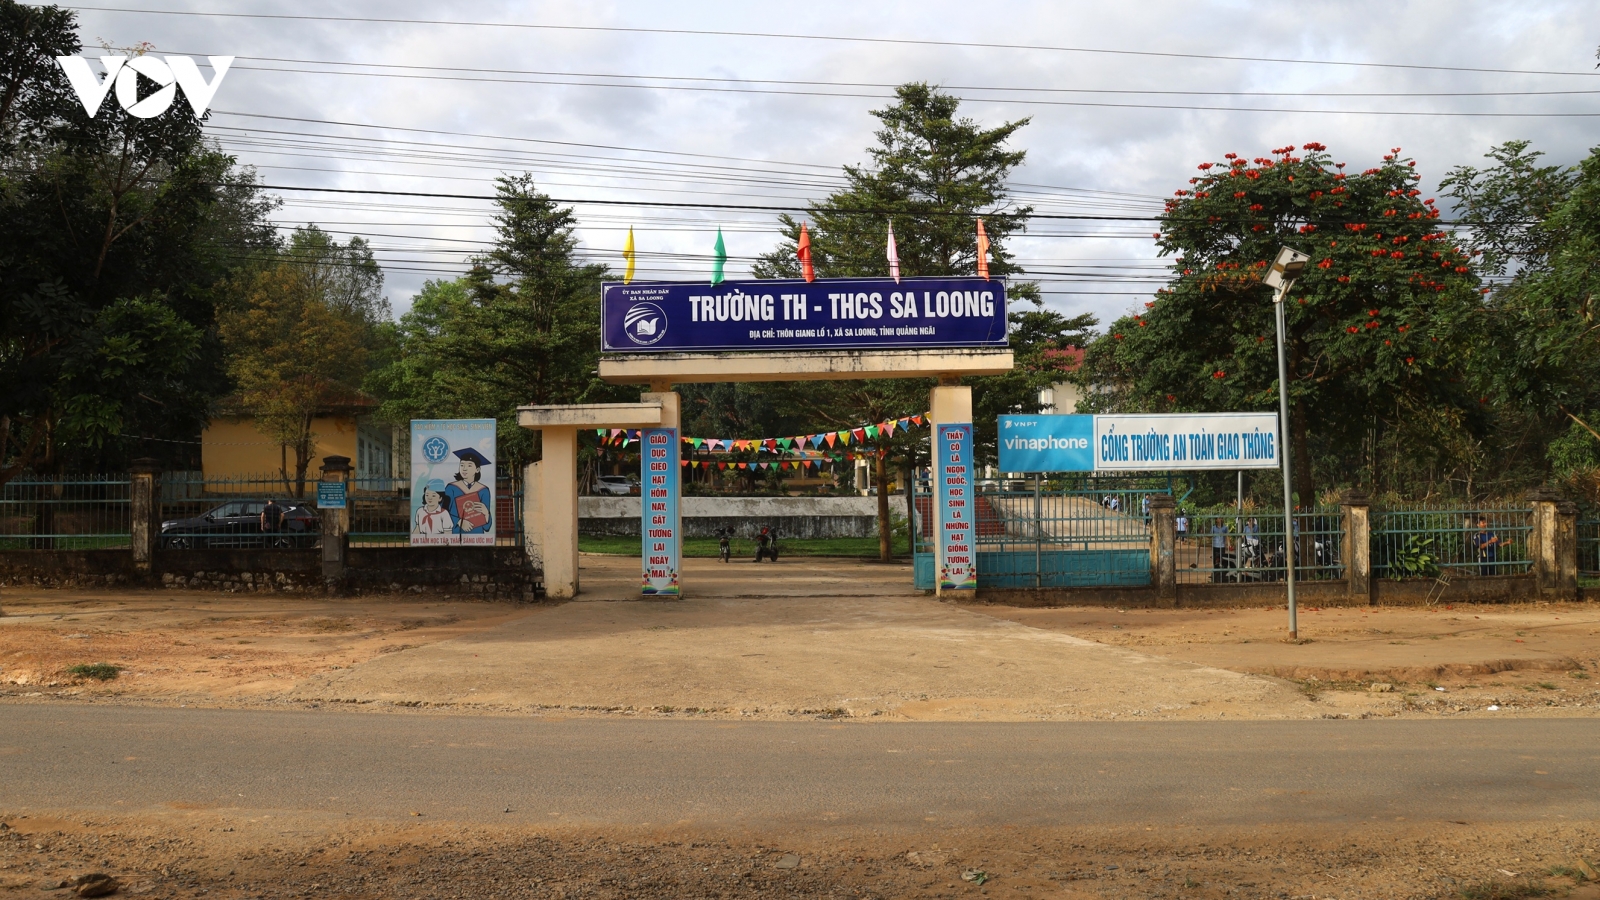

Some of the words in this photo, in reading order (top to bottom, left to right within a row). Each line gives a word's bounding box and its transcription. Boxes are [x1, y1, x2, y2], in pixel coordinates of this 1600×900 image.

[689, 289, 774, 321] TRƯỜNG
[781, 294, 807, 320] TH
[828, 292, 883, 319] THCS
[890, 292, 918, 318] SA
[924, 291, 994, 317] LOONG
[750, 330, 760, 340] ĐỊA
[762, 328, 775, 338] CHỈ:
[777, 328, 794, 338] THÔN
[795, 329, 815, 337] GIANG
[827, 329, 832, 337] 1,
[834, 327, 843, 337] XÃ
[855, 328, 878, 337] LOONG,
[880, 326, 894, 336] TỈNH
[896, 325, 918, 336] QUẢNG
[920, 326, 935, 335] NGÃI
[482, 422, 492, 430] VIÊN
[650, 433, 667, 444] GIÁO
[1005, 435, 1088, 451] vinaphone
[1101, 424, 1128, 461] CỔNG
[1131, 428, 1169, 461] TRƯỜNG
[1173, 434, 1186, 460] AN
[1189, 428, 1214, 460] TOÀN
[1218, 433, 1239, 460] GIAO
[1242, 427, 1274, 459] THÔNG
[950, 442, 960, 451] CÔ
[651, 448, 666, 460] DỤC
[650, 462, 667, 471] GIEO
[946, 466, 966, 475] NGỌN
[652, 475, 666, 486] HẠT
[947, 475, 967, 485] ĐUỐC,
[650, 487, 668, 498] HÔM
[949, 488, 963, 497] HỌC
[652, 502, 666, 511] NAY,
[952, 510, 961, 518] LÀ
[652, 514, 666, 526] GẶT
[945, 521, 969, 530] NHỮNG
[649, 529, 672, 538] TƯƠNG
[951, 533, 964, 542] HẠT
[653, 542, 665, 551] LAI
[947, 543, 968, 553] GIỐNG
[650, 555, 669, 565] NGÀY
[651, 569, 667, 578] MAI.
